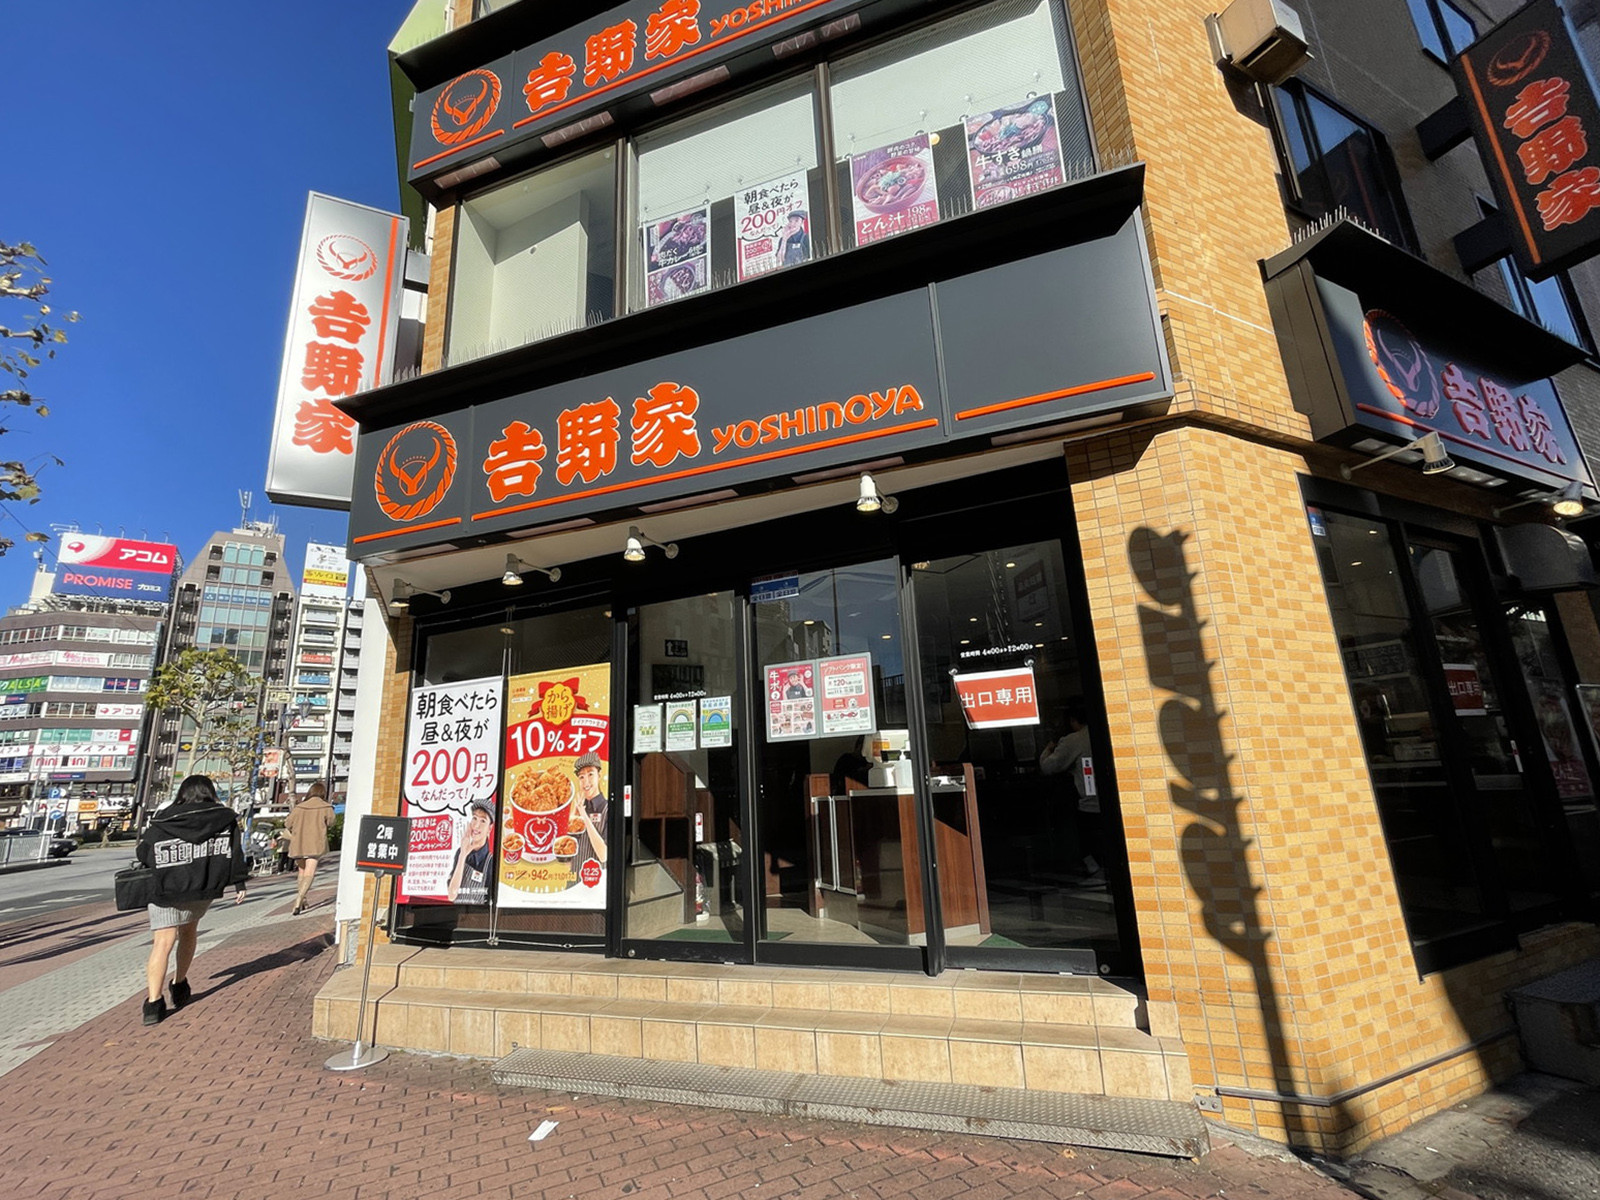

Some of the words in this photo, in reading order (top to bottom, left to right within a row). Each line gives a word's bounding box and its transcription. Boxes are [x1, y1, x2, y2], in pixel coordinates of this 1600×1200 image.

[522, 0, 702, 114] 吉野家
[1503, 77, 1600, 232] 吉野家
[743, 178, 799, 205] 朝食べたら
[748, 192, 795, 216] 昼&夜が
[861, 211, 905, 235] とん汁
[291, 289, 372, 456] 吉野家
[1440, 362, 1567, 466] 吉野家
[482, 381, 702, 503] 吉野家
[711, 384, 924, 455] YOSHINOYA
[118, 548, 168, 564] アコム
[63, 572, 134, 590] PROMISE
[415, 688, 498, 720] 朝食べたら
[547, 688, 570, 704] から
[960, 686, 1032, 709] 出口専用
[420, 717, 490, 746] 昼&夜が
[511, 721, 606, 761] 10%オフ
[52, 790, 60, 798] P
[421, 788, 469, 802] なんだって!
[376, 823, 394, 840] 2階
[367, 842, 399, 860] 営業中
